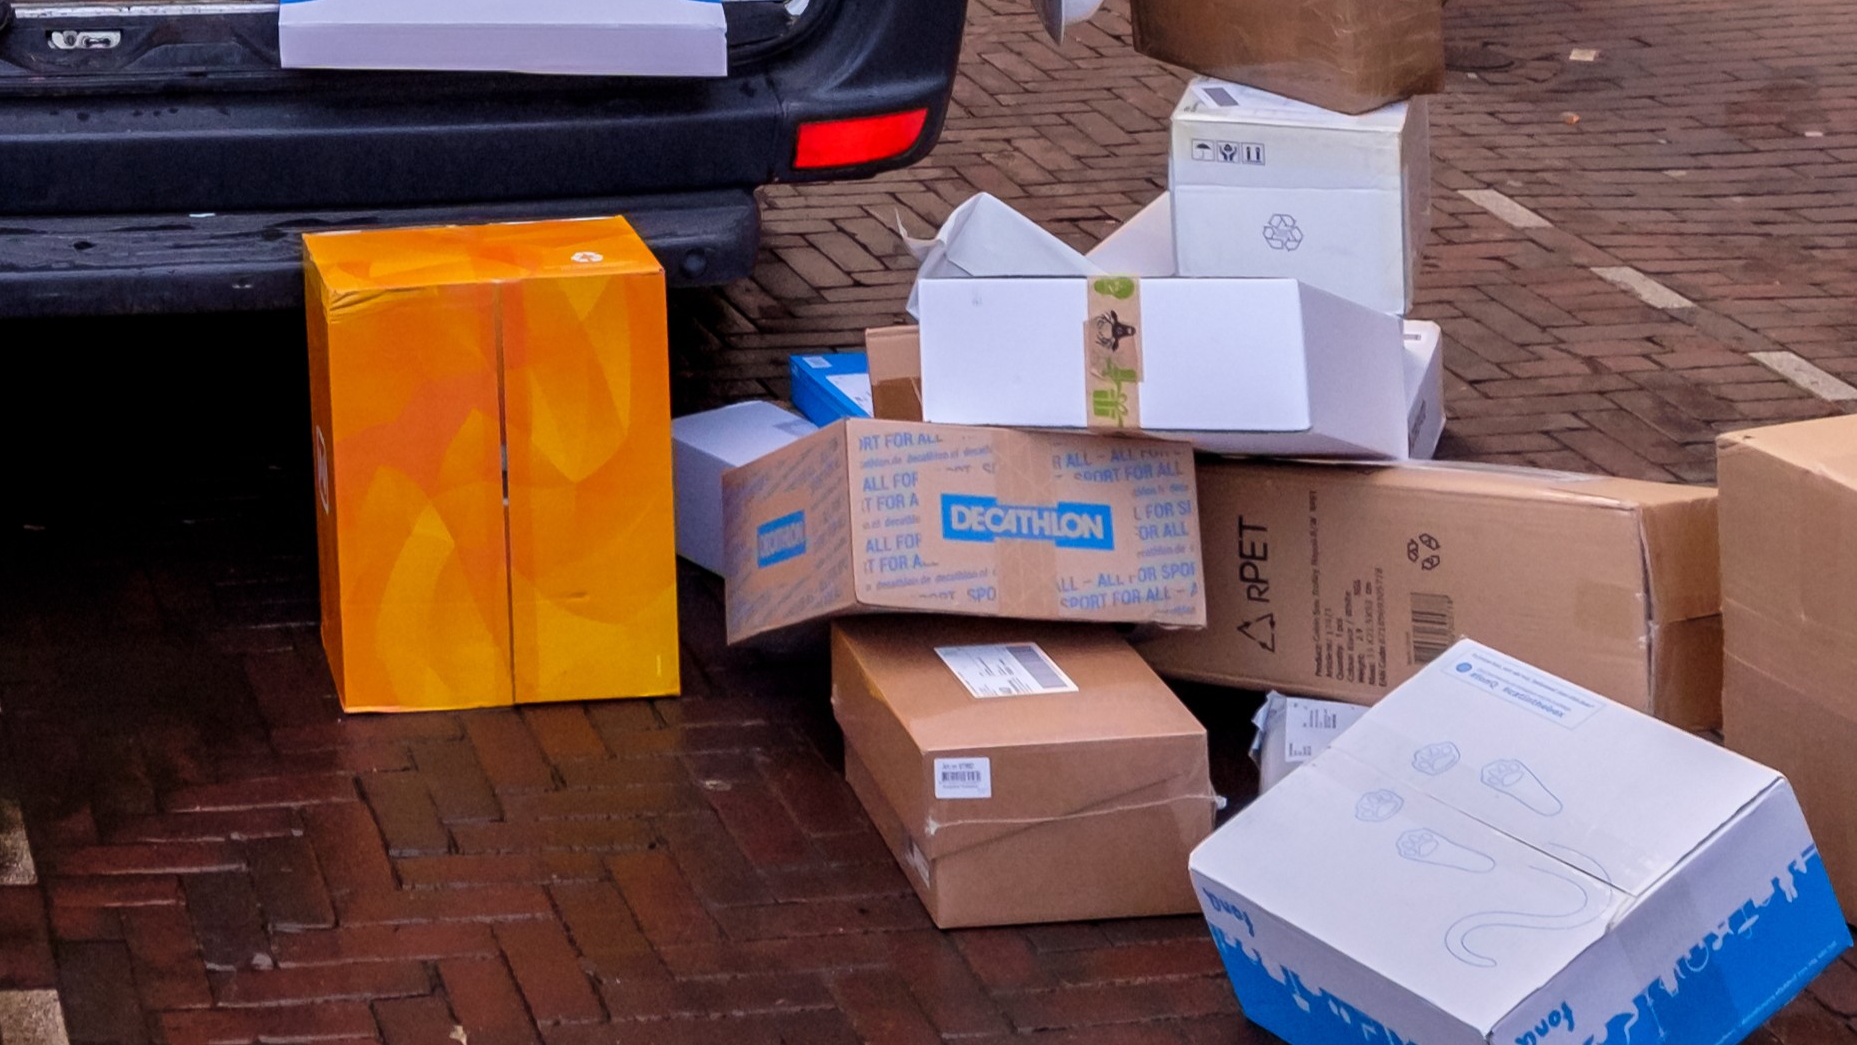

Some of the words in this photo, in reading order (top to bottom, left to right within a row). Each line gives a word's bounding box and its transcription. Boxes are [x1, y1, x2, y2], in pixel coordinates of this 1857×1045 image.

[885, 432, 913, 449] FOR
[863, 476, 889, 492] ALL
[877, 494, 906, 511] FOR
[950, 503, 1105, 541] DECATHLON
[1163, 521, 1190, 537] ALL
[866, 538, 892, 553] ALL
[879, 555, 909, 572] FOR
[1146, 584, 1172, 602] ALL
